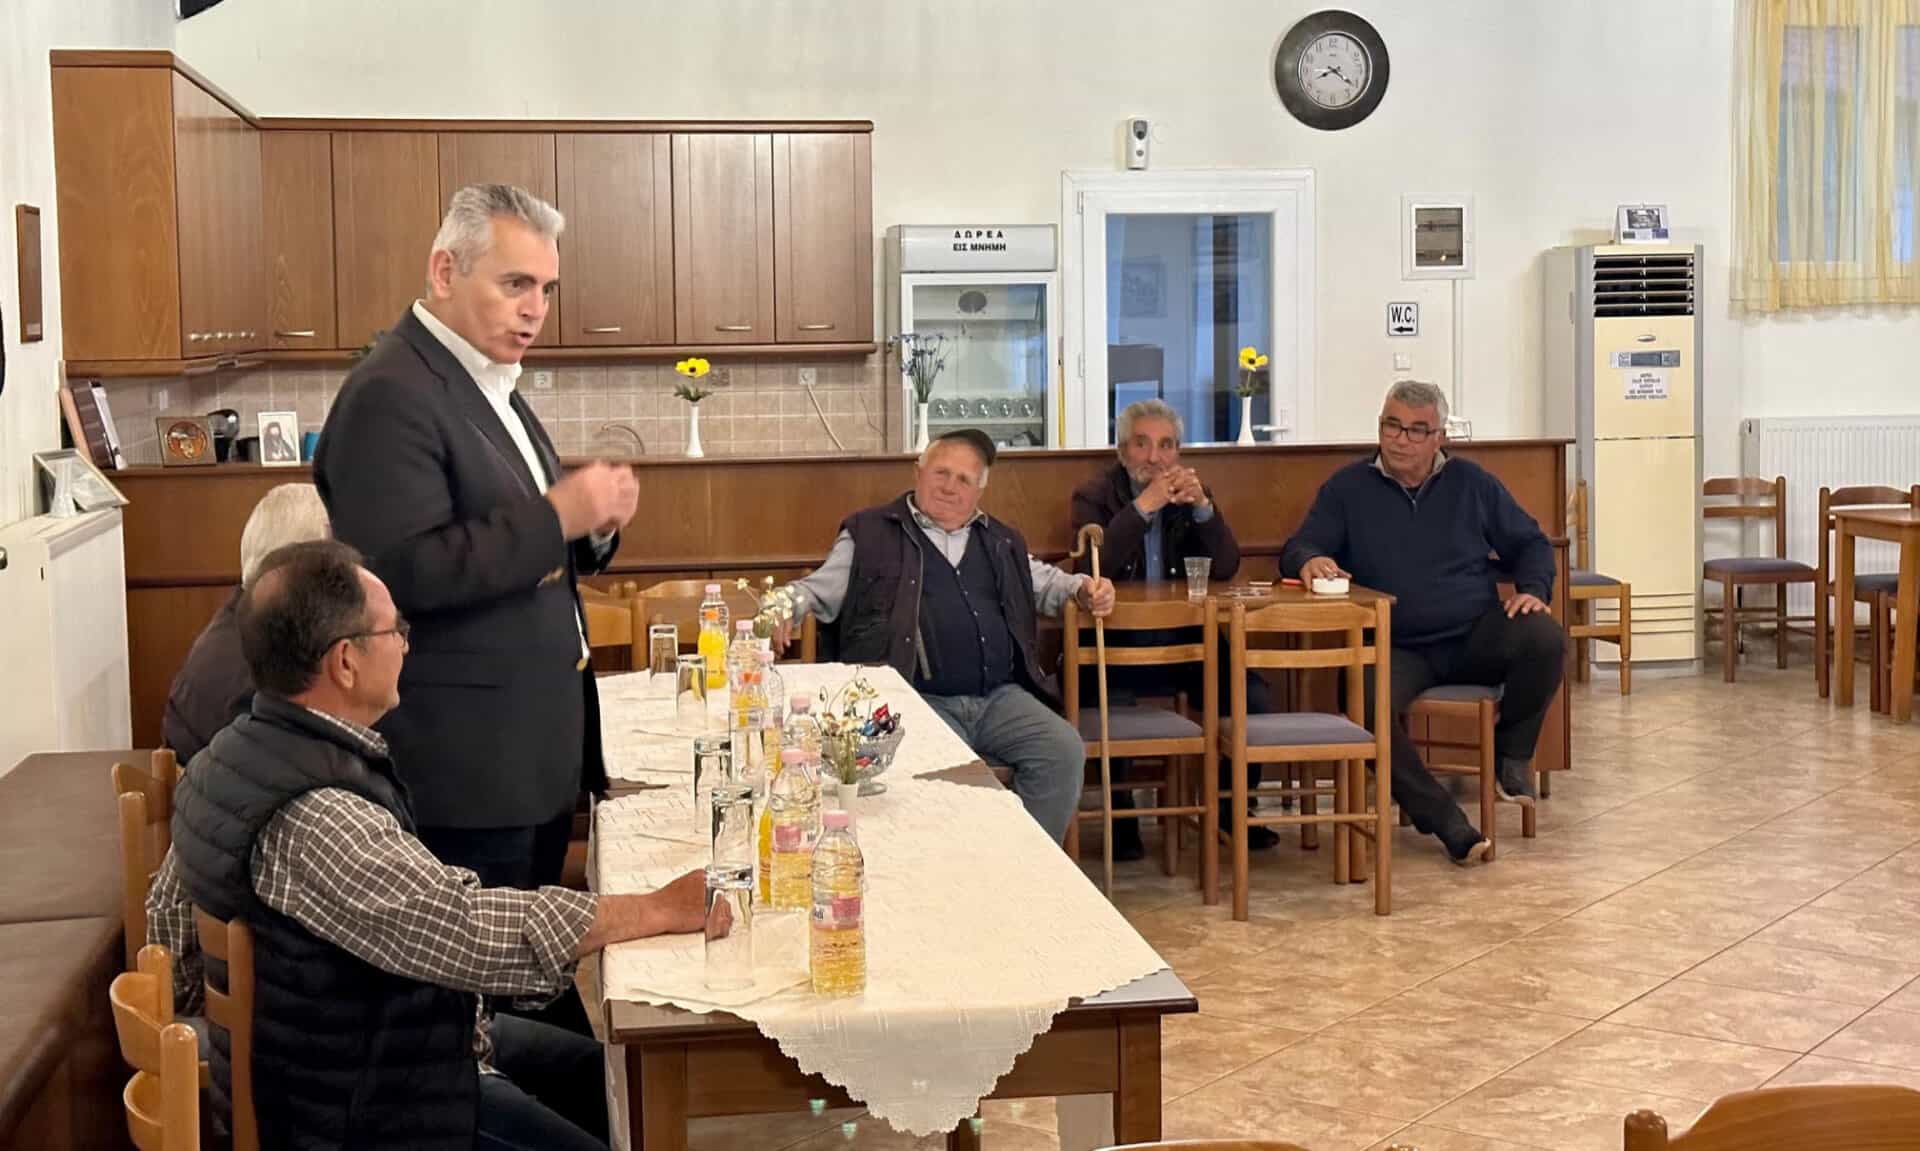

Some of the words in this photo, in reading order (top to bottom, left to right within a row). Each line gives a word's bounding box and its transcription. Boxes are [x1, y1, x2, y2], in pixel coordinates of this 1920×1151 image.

[953, 243, 968, 251] ΕΙΣ
[970, 243, 1006, 251] ΜΝΗΜΗ
[1391, 306, 1415, 323] W.C.
